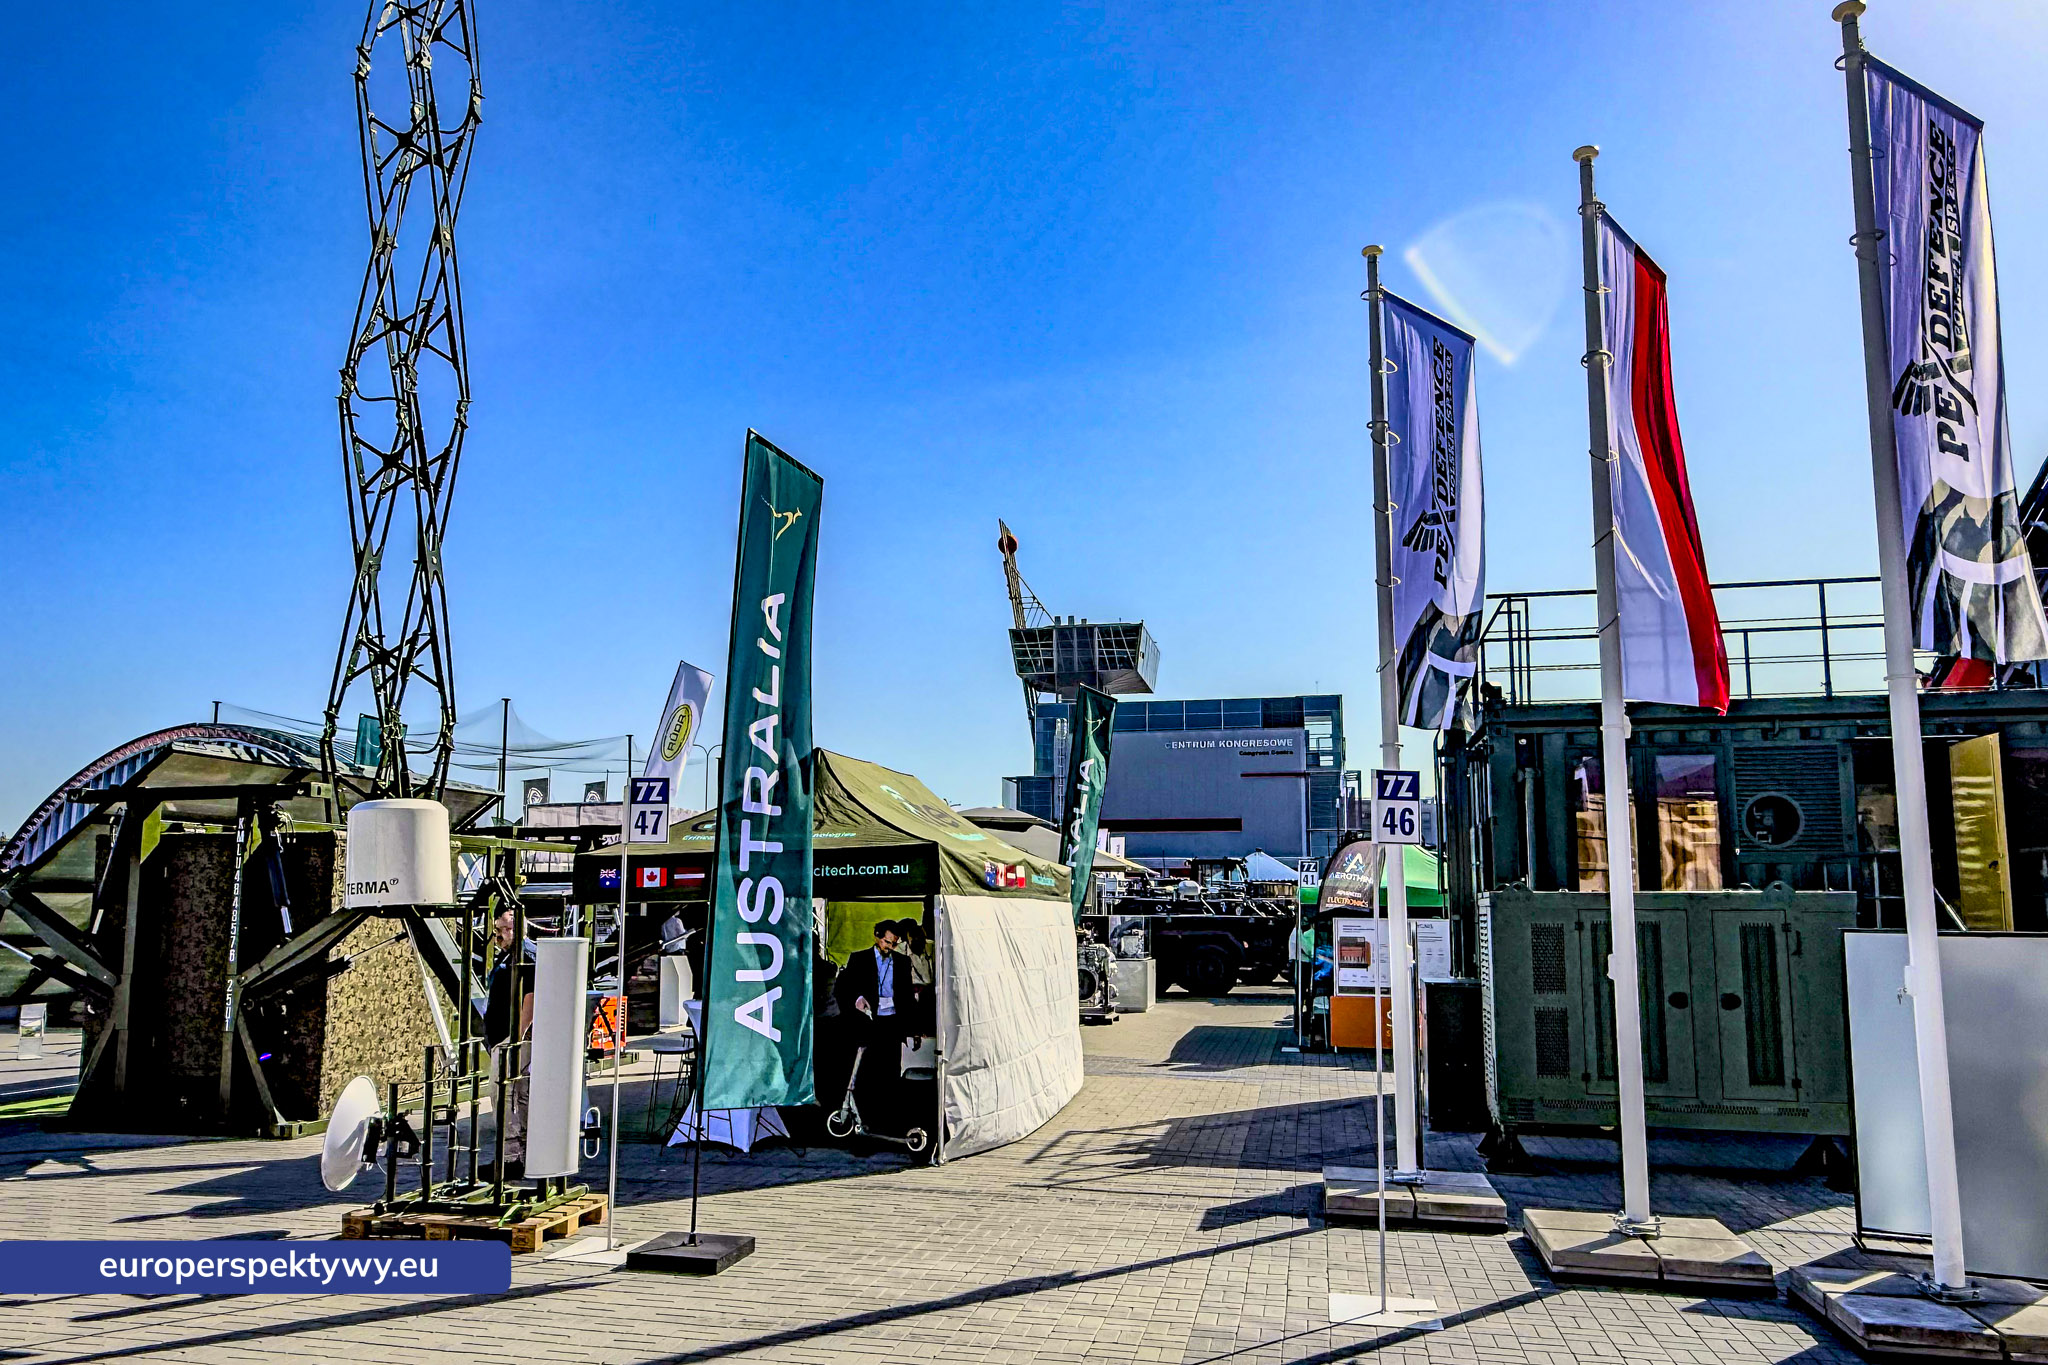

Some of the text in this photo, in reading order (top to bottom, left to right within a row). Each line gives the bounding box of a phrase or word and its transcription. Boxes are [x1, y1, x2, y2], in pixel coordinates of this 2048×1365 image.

[1164, 738, 1293, 750] CENTRUM KONGRESOWE
[636, 781, 663, 802] 7Z
[1383, 774, 1413, 798] 7Z
[634, 810, 663, 836] 47
[734, 593, 786, 1043] AUSTRALIA
[1382, 807, 1415, 836] 46
[1302, 862, 1316, 872] 7Z
[346, 880, 390, 896] TERMA
[1302, 874, 1316, 886] 41
